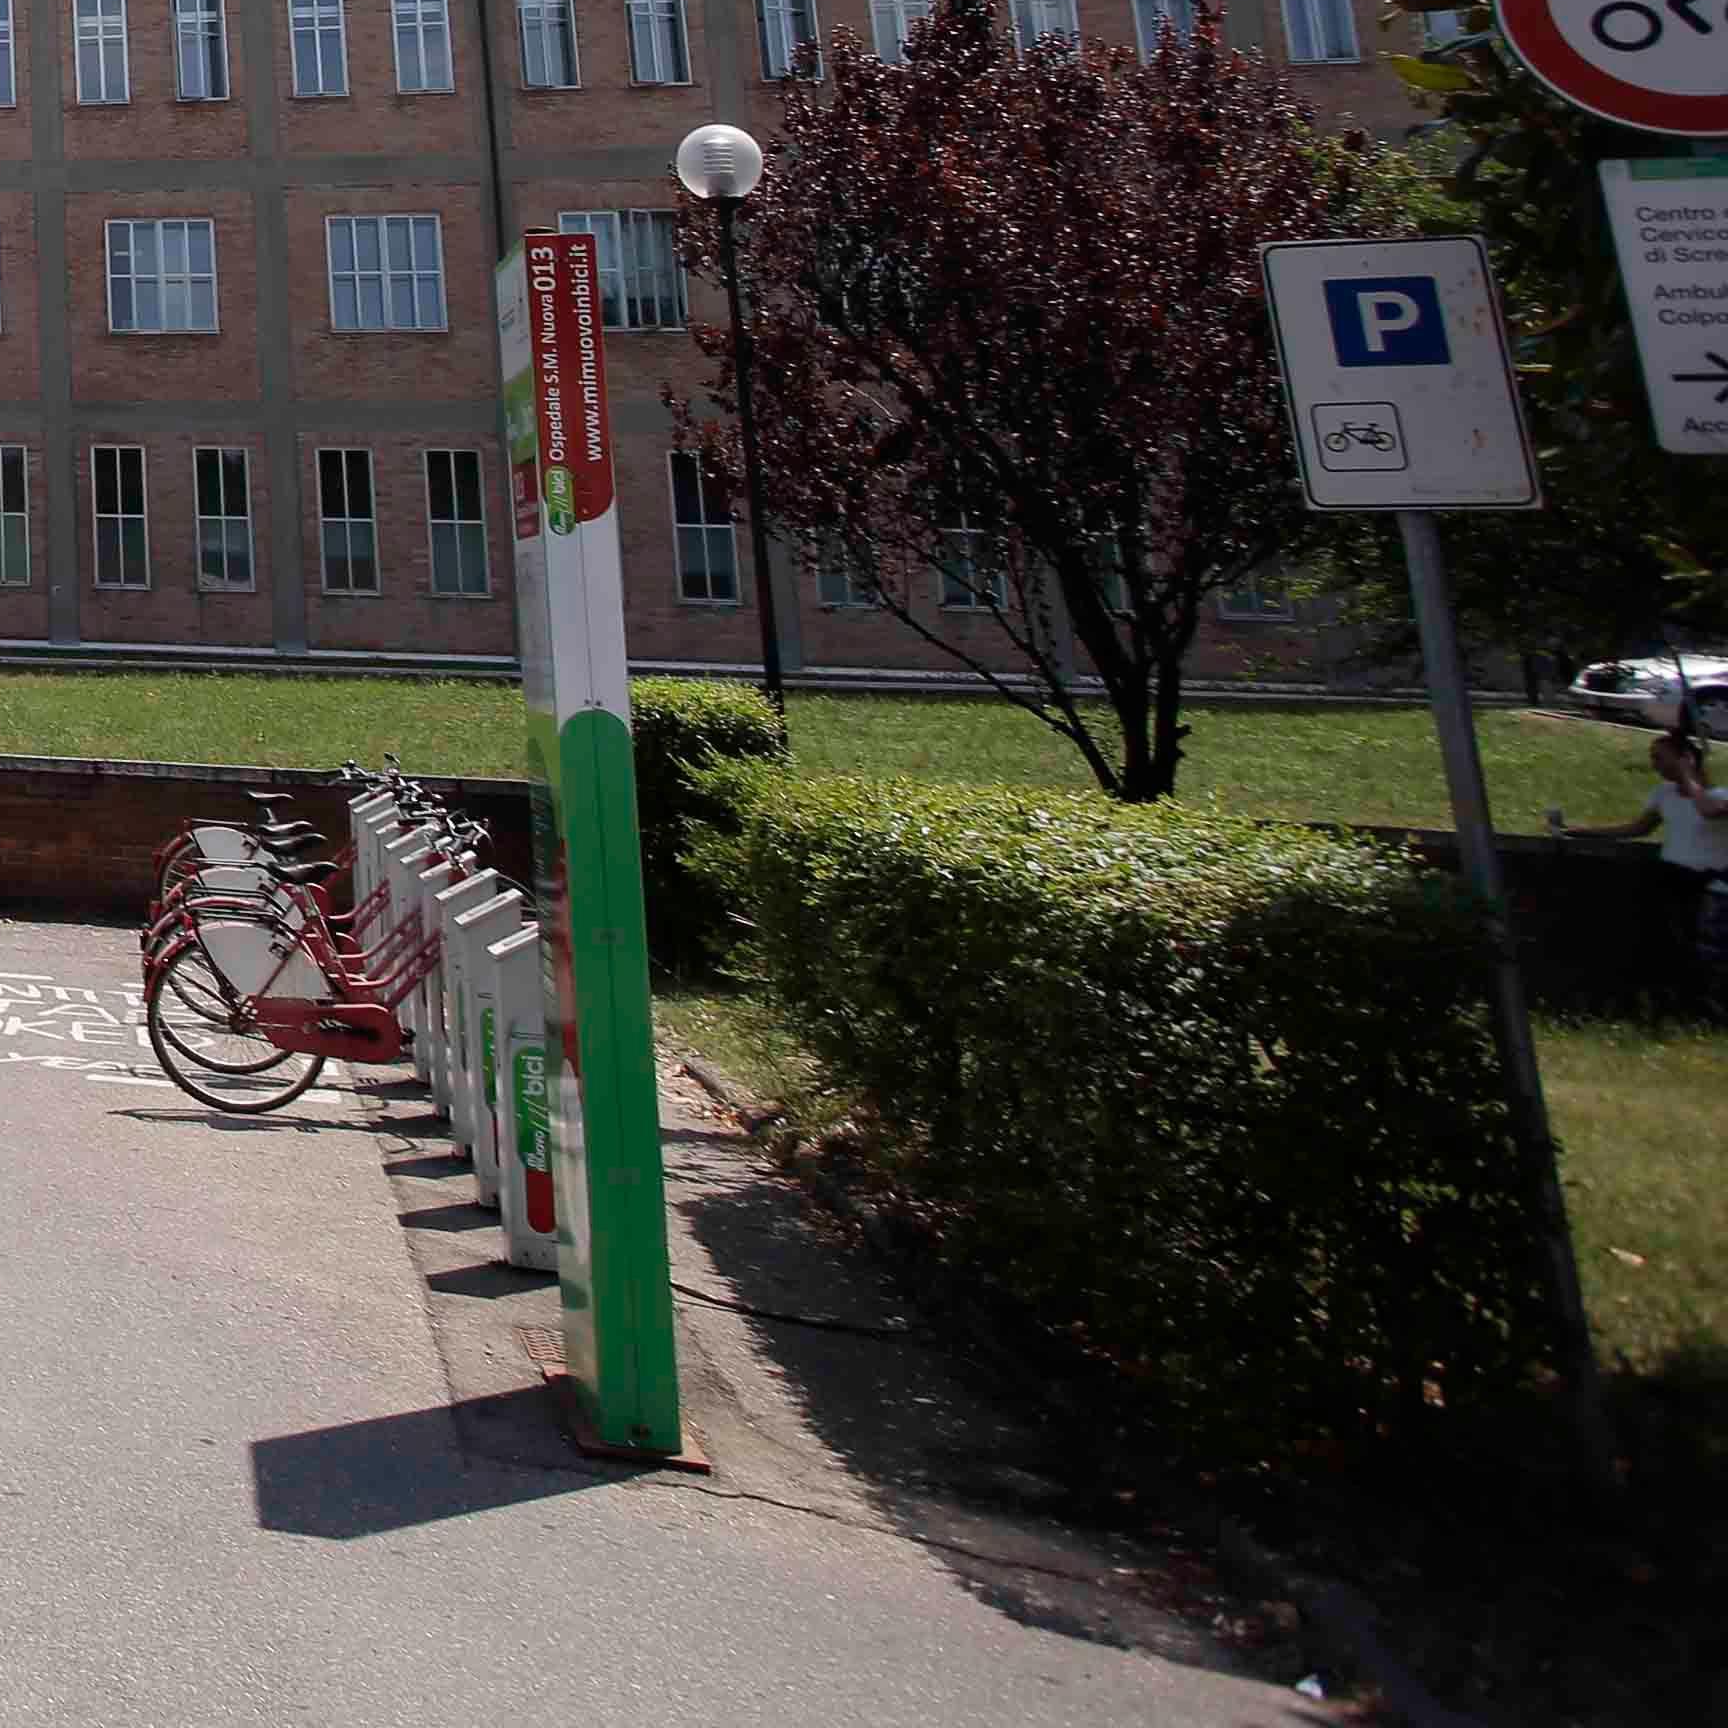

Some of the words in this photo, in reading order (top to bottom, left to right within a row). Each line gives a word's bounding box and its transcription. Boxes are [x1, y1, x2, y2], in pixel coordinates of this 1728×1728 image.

[1636, 207, 1714, 222] Centro
[531, 247, 556, 291] 013
[1645, 247, 1668, 263] di
[540, 294, 557, 344] Nuova
[1357, 291, 1420, 351] P
[542, 348, 560, 383] S.M.
[569, 243, 603, 461] www.mimuovoinbici.it
[544, 387, 567, 461] Ospedale
[521, 1055, 545, 1096] bici
